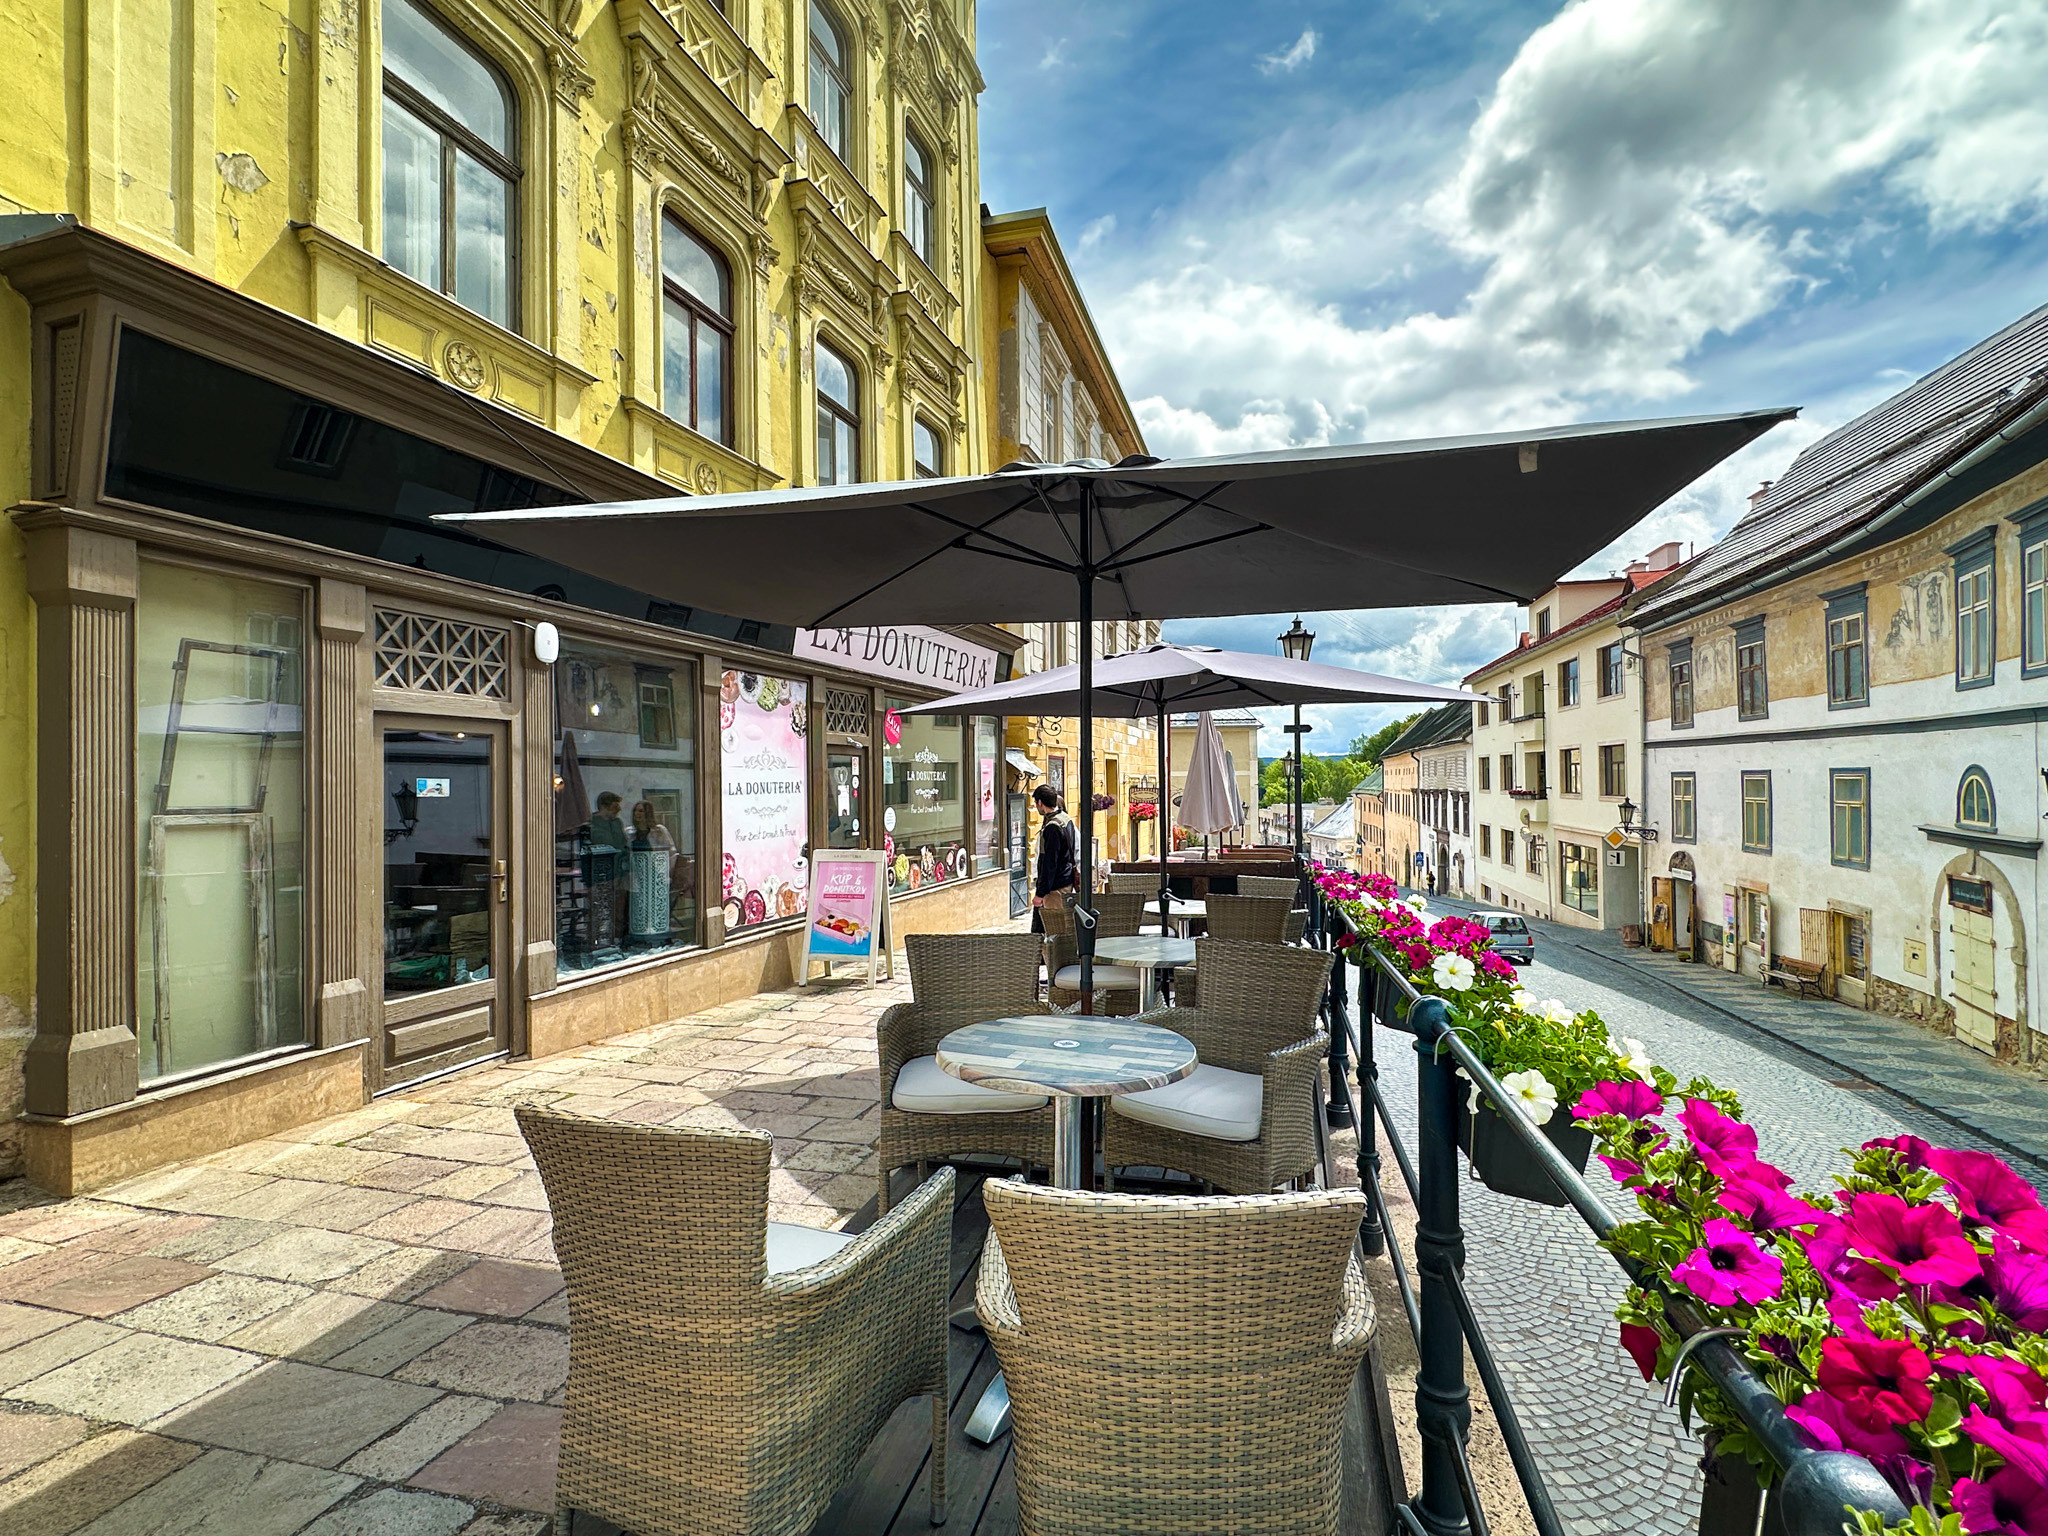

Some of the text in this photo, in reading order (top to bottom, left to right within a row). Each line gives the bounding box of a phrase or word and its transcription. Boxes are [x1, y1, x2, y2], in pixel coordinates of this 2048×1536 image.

[862, 626, 988, 688] DONUTERIA
[907, 771, 915, 781] LA
[728, 781, 801, 796] LA DONUTERIA
[830, 872, 853, 885] KÚP
